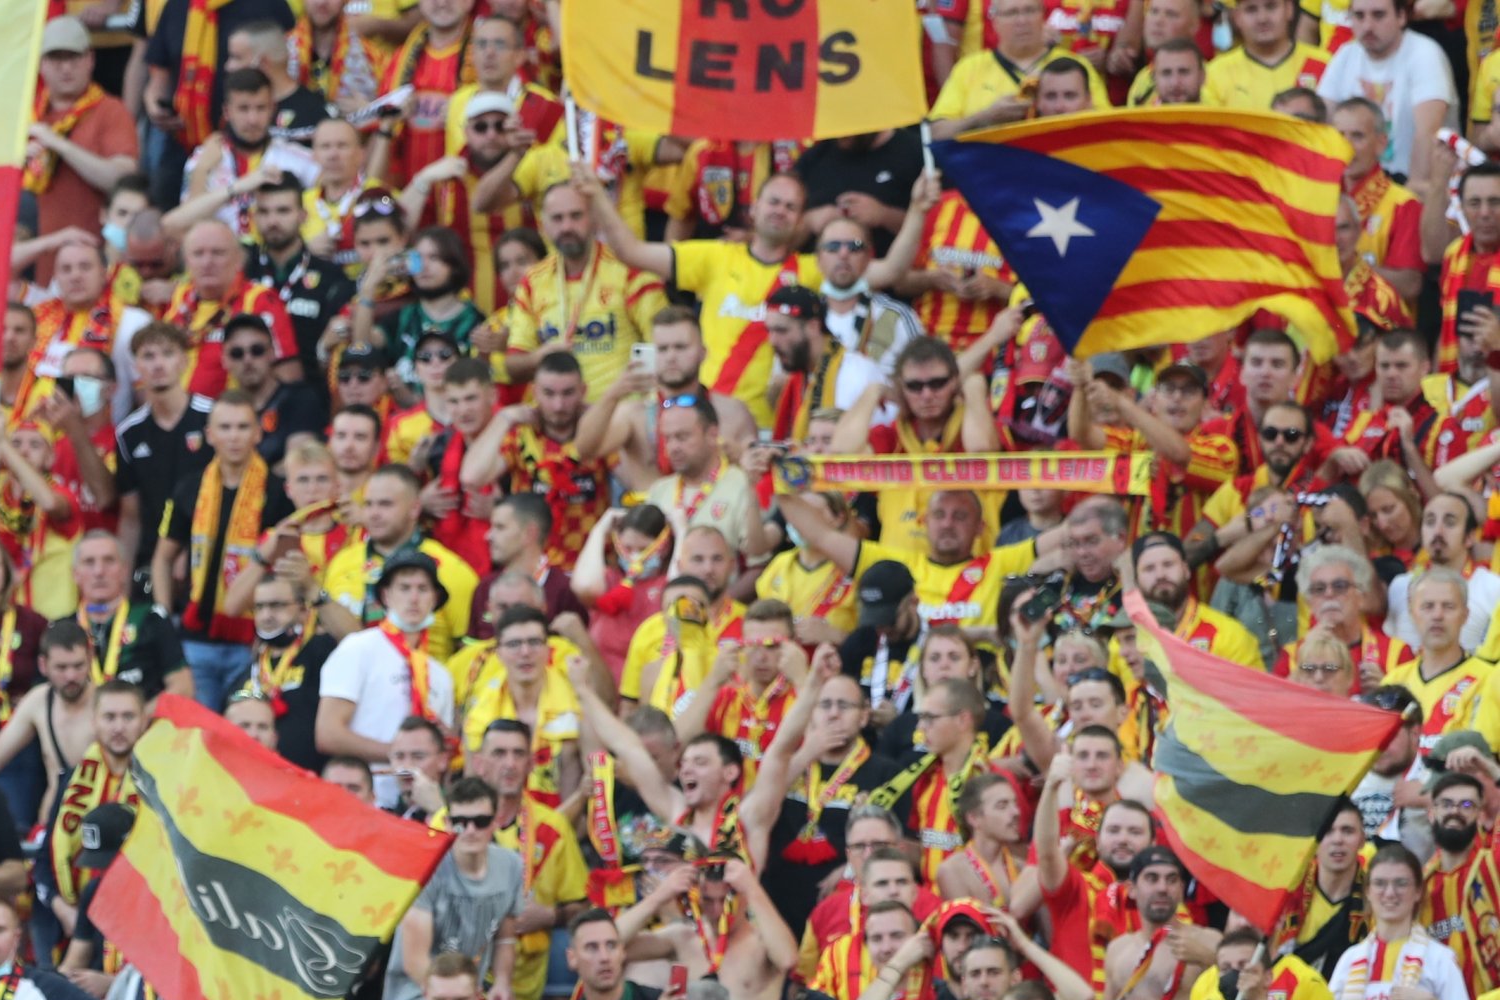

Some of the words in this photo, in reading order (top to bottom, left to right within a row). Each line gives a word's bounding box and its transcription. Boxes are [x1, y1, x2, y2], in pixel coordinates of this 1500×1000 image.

[636, 30, 860, 92] LENS
[823, 459, 913, 481] RACING
[922, 459, 989, 481] CLUB
[998, 459, 1034, 481] DE
[1039, 458, 1108, 481] LENS
